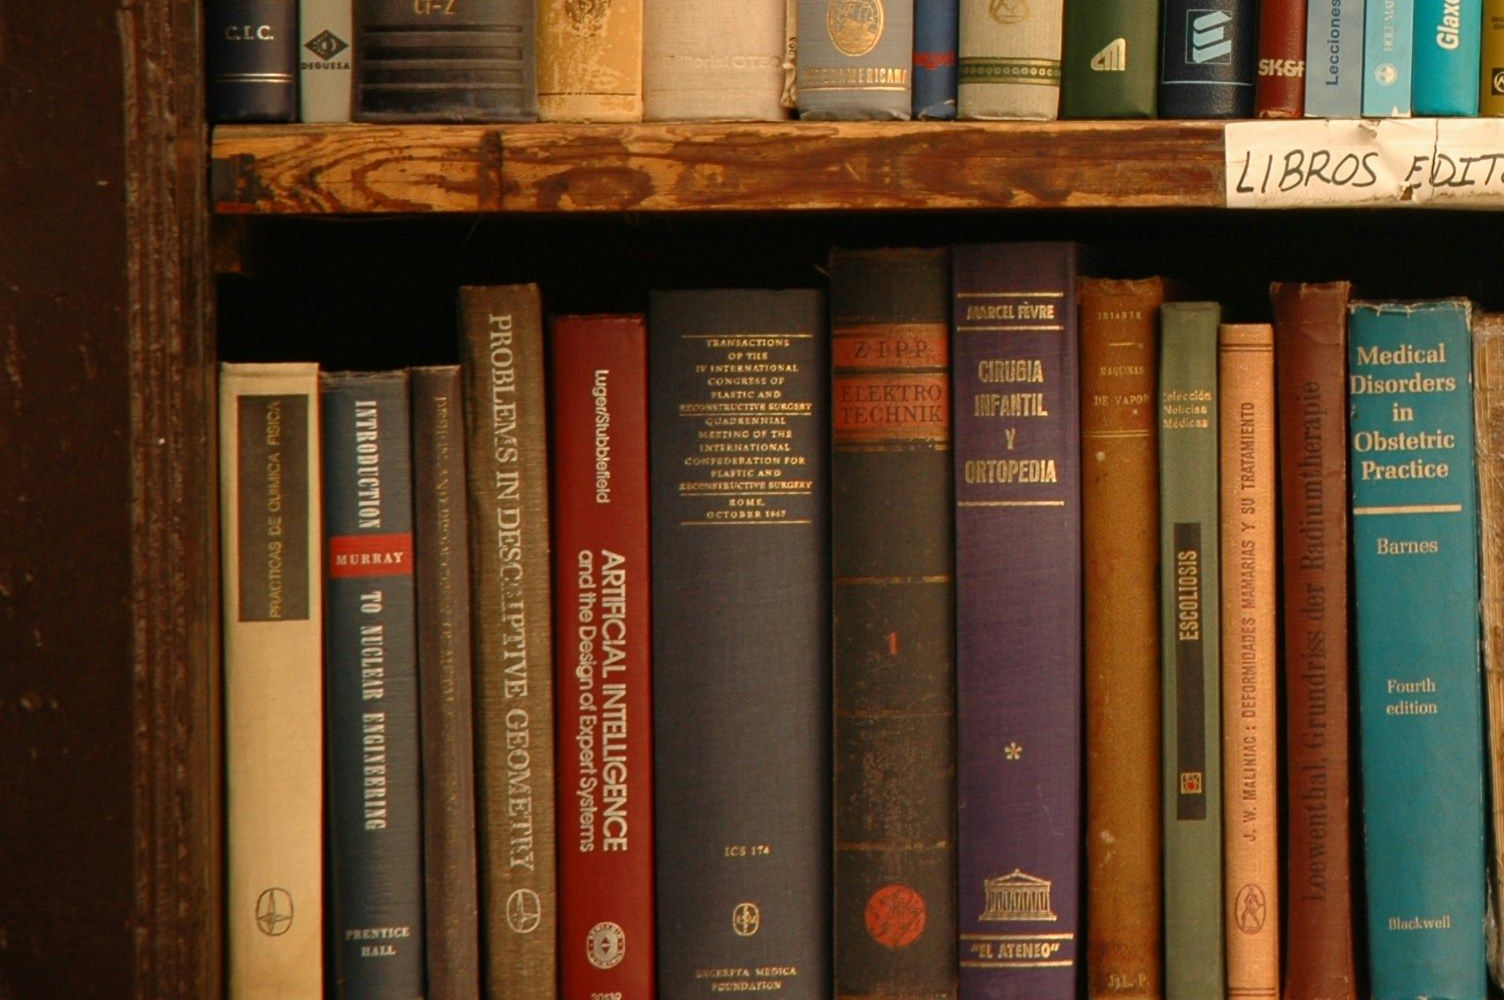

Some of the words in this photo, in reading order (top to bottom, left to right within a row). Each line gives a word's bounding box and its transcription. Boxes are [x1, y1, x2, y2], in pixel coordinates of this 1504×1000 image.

[301, 62, 351, 71] DEGUSSA
[1236, 149, 1379, 194] LIBROS
[966, 305, 1015, 321] MARCEL
[706, 338, 790, 348] TRANSACTIONS
[1356, 343, 1446, 366] Medical
[707, 377, 767, 386] CONGRESS
[978, 359, 1044, 384] CIRUGIA
[1350, 373, 1456, 395] Disorders
[841, 405, 945, 424] TECHNIK
[974, 393, 1048, 417] INFANTIL
[591, 369, 610, 504] Luger/Stubblefield
[1241, 401, 1255, 490] TRATAMIENTO
[1353, 430, 1455, 452] Obstetric
[355, 400, 381, 529] INTRODUCTION
[964, 459, 1057, 484] ORTOPEDIA
[1361, 459, 1449, 481] Practice
[706, 510, 762, 520] OCTOBER
[1376, 537, 1439, 555] Barnes
[336, 552, 404, 566] MURRAY
[578, 551, 593, 586] and
[268, 543, 282, 618] PRACTICAS
[1241, 537, 1256, 609] MAMARIAS
[489, 313, 518, 464] PROBLEMS
[504, 708, 534, 872] GEOMETRY
[1178, 549, 1199, 641] ESCOLIOSIS
[601, 549, 627, 679] ARTIFICIAL
[360, 624, 384, 701] NUCLEAR
[1242, 617, 1256, 718] DEFORMIDADES
[1386, 678, 1436, 694] Fourth
[1386, 700, 1438, 715] edition
[576, 714, 597, 774] Expert
[362, 712, 386, 831] ENGINEERING
[602, 684, 628, 852] INTELLIGENCE
[576, 778, 598, 853] Systems
[345, 926, 410, 941] PRENTICE
[1388, 915, 1451, 931] Blackwell
